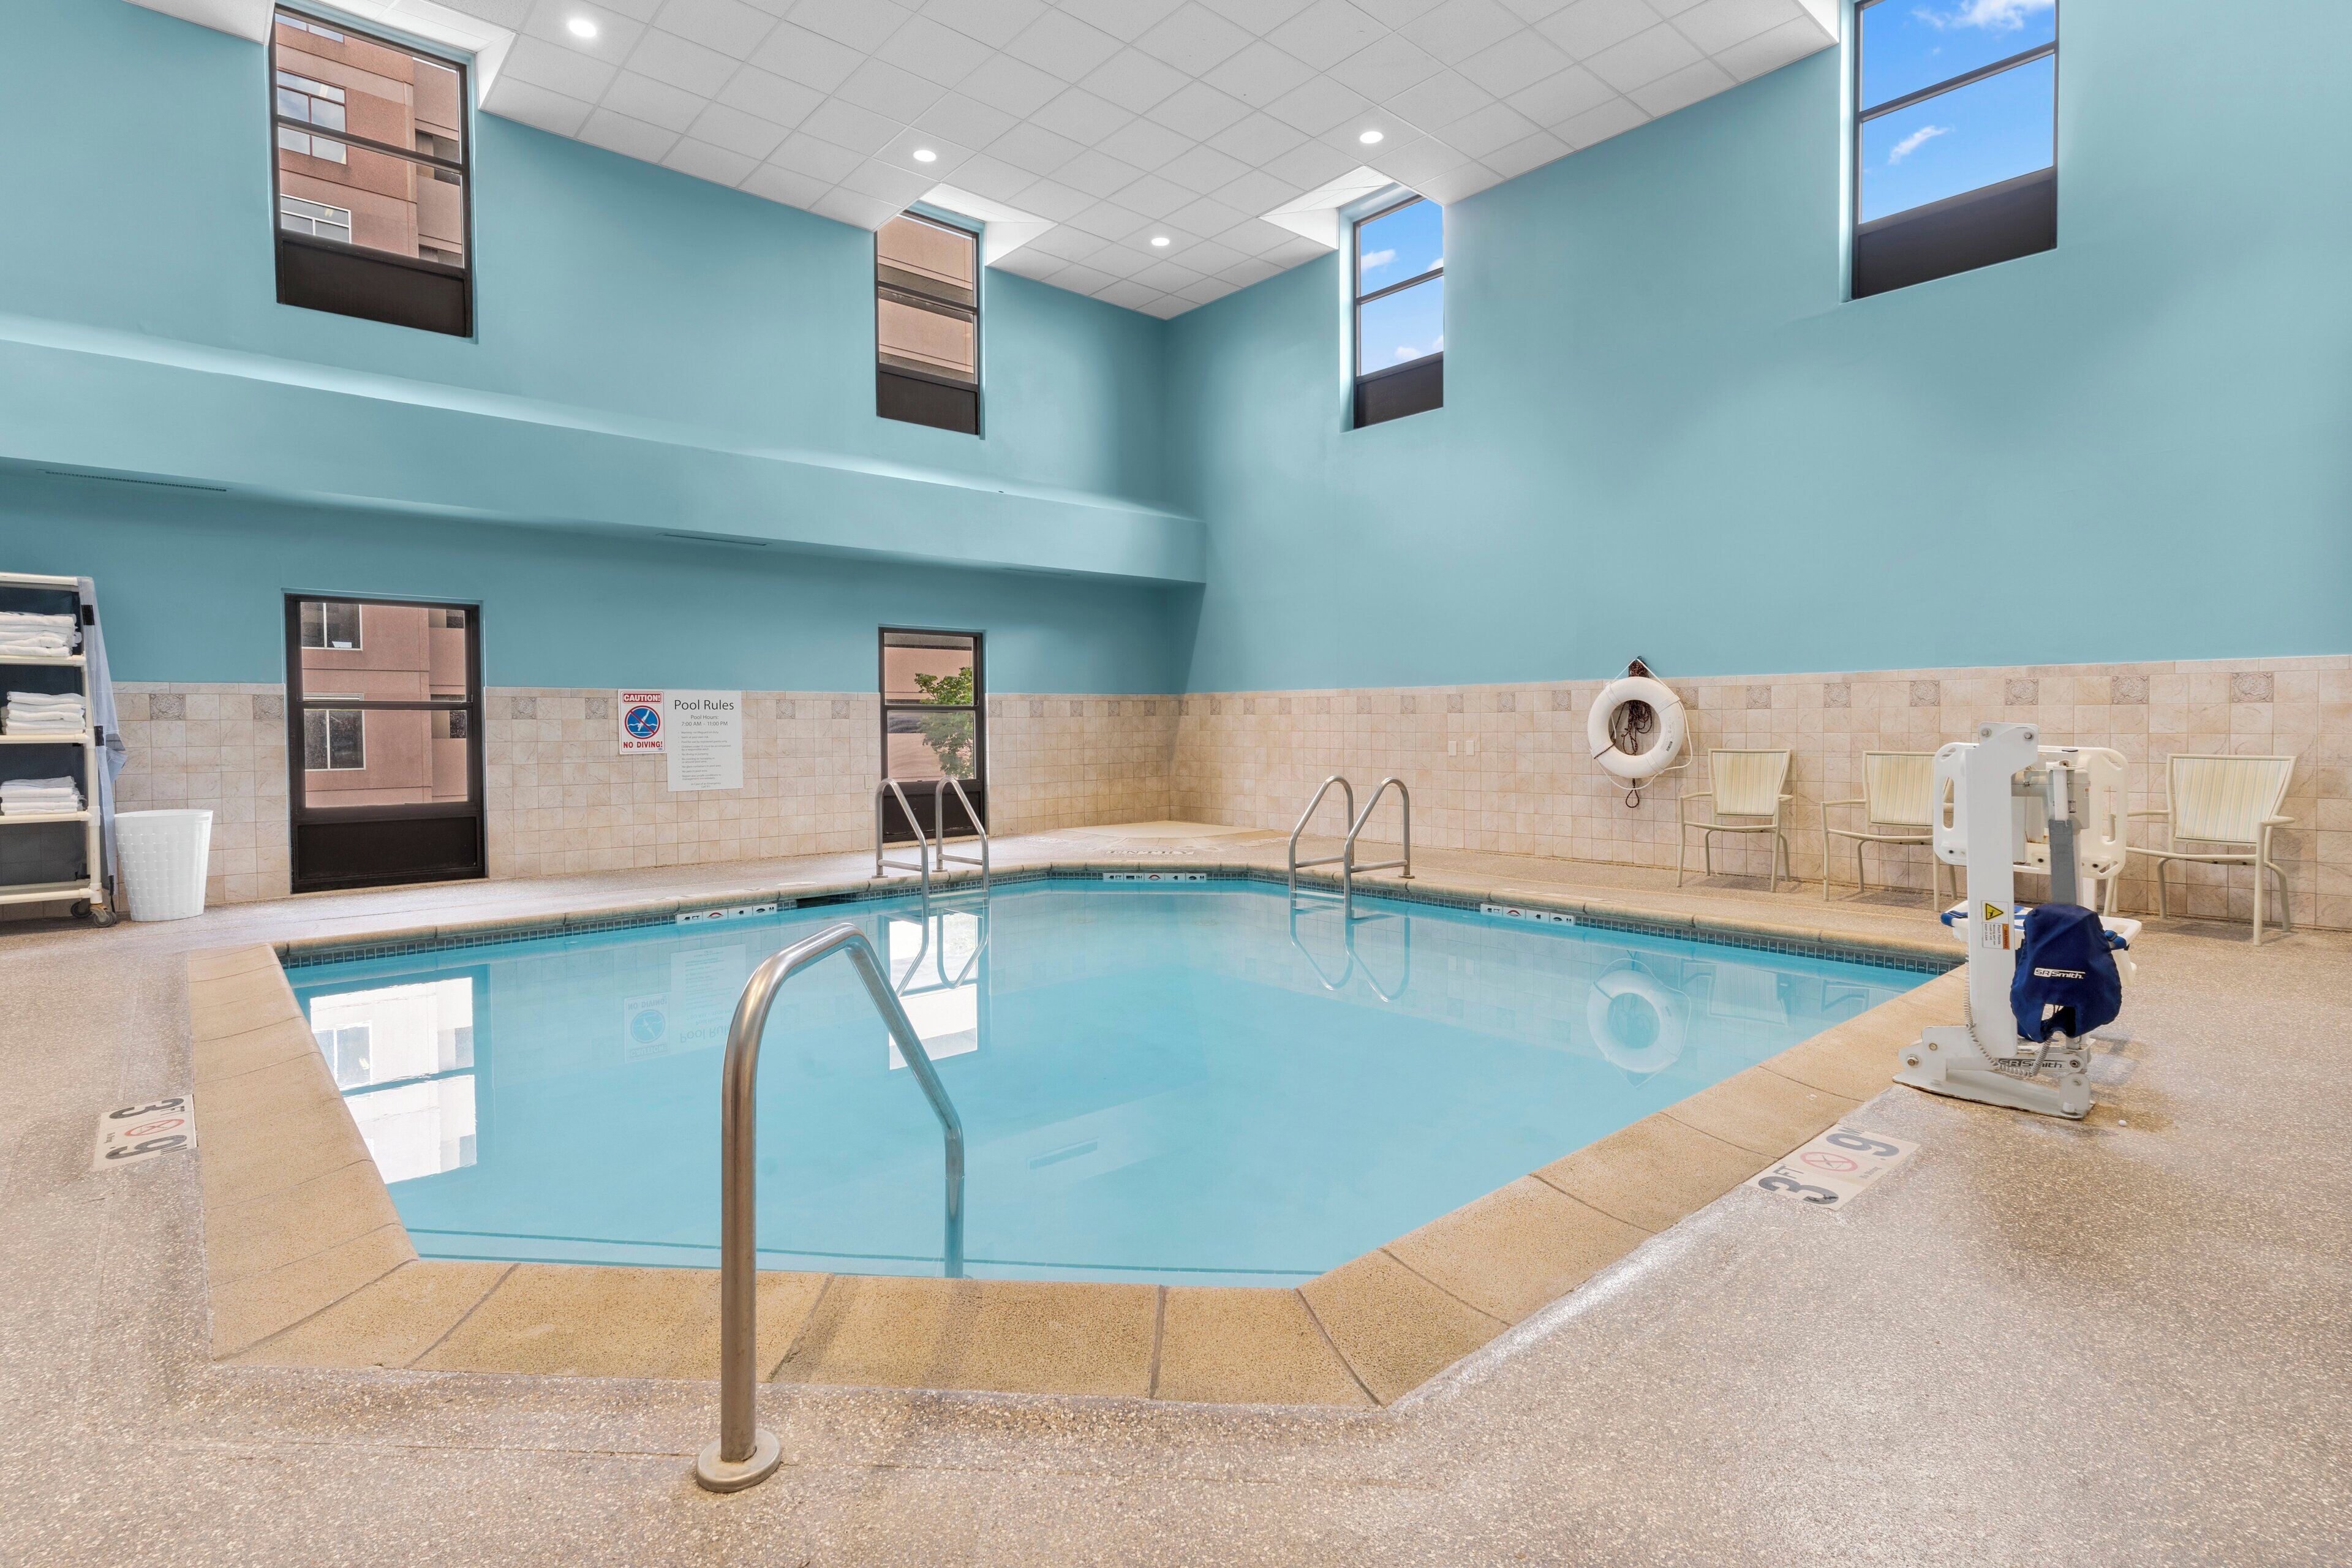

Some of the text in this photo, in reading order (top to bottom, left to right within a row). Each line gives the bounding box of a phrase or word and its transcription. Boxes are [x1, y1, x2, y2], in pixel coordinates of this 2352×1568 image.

[674, 699, 734, 710] Pool Rules
[109, 1098, 185, 1119] 3 FT
[1838, 1126, 1865, 1136] M
[160, 1144, 187, 1155] M
[1758, 1165, 1839, 1205] 3 FT
